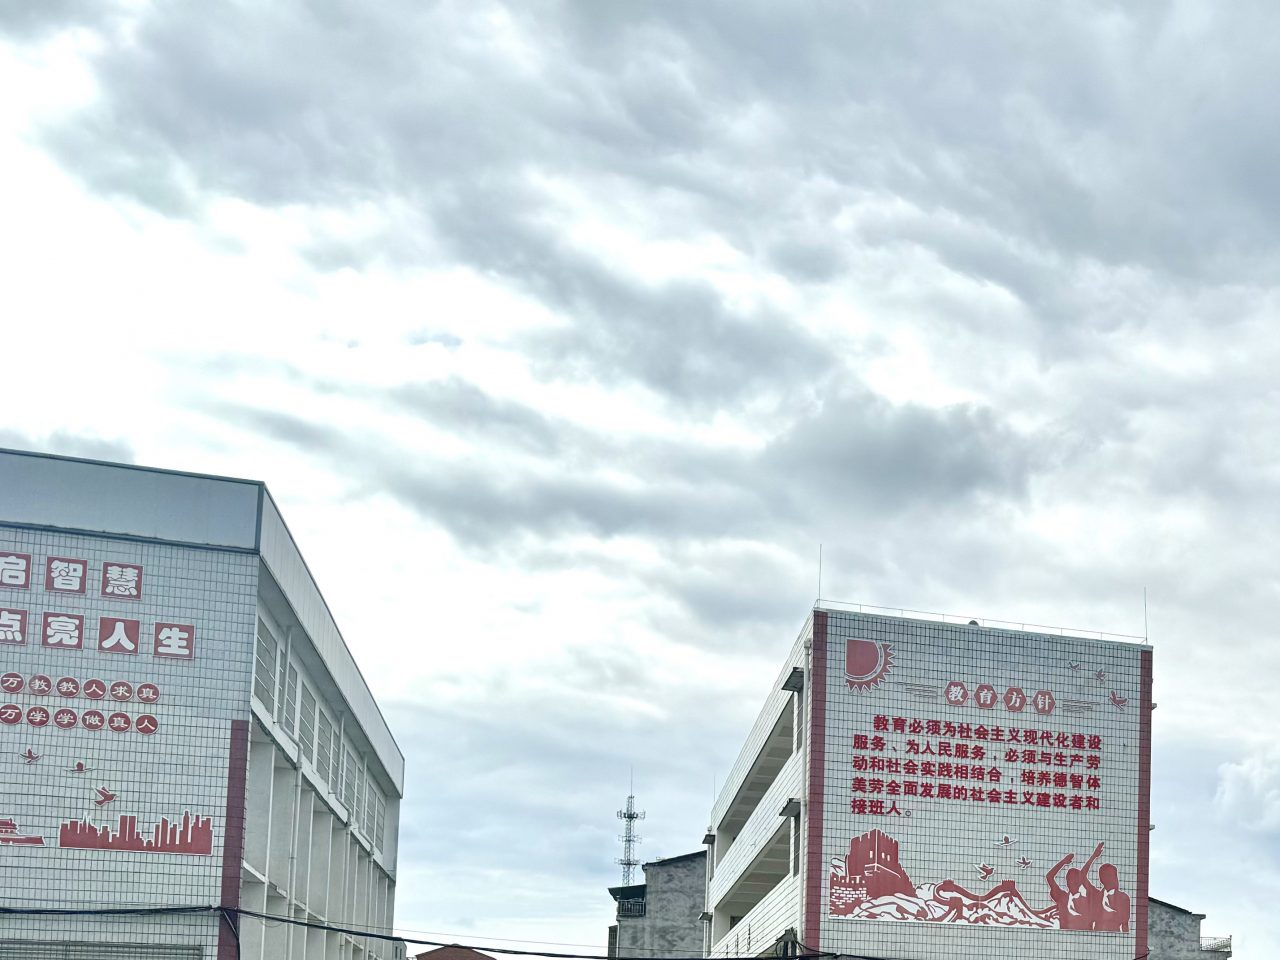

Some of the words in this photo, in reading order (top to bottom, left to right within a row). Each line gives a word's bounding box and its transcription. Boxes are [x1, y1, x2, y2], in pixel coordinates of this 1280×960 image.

[0, 555, 138, 596] 启智慧
[0, 610, 190, 655] 点亮人生
[2, 676, 158, 700] 万教教人求真
[948, 685, 1052, 711] 教育方针
[0, 708, 157, 731] 万学学做真人
[873, 715, 1102, 750] 教育必须为社会主义现代化建设
[853, 734, 1101, 770] 服务、为人民服务，必须与生产劳
[852, 755, 1101, 790] 动和社会实践相结合，培养德智体
[851, 776, 1101, 810] 美劳全面发展的社会主义建设者和
[851, 797, 912, 817] 接班人。
